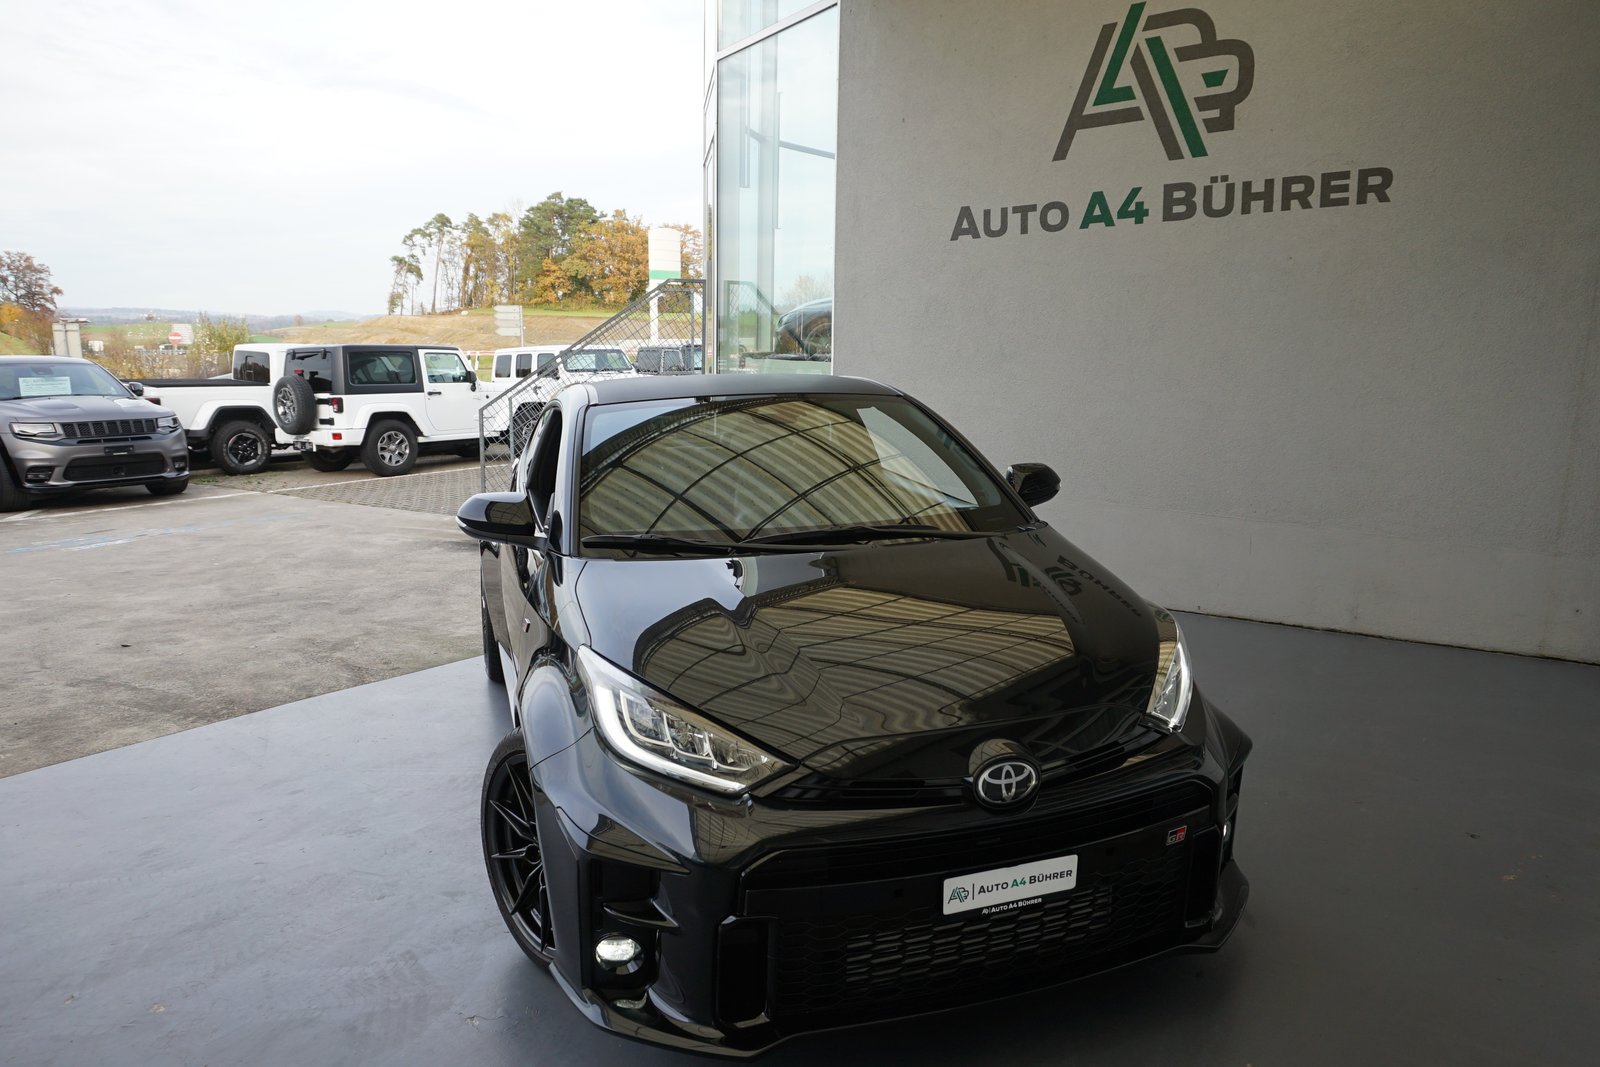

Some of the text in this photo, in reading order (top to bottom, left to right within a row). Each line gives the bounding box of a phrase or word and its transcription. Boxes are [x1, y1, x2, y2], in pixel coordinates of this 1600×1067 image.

[950, 166, 1395, 241] AUTO A4 BÜHRER
[978, 881, 1009, 895] AUTO
[1010, 876, 1027, 888] A4
[1028, 869, 1073, 885] BÜHRER
[990, 905, 1008, 913] AUTO
